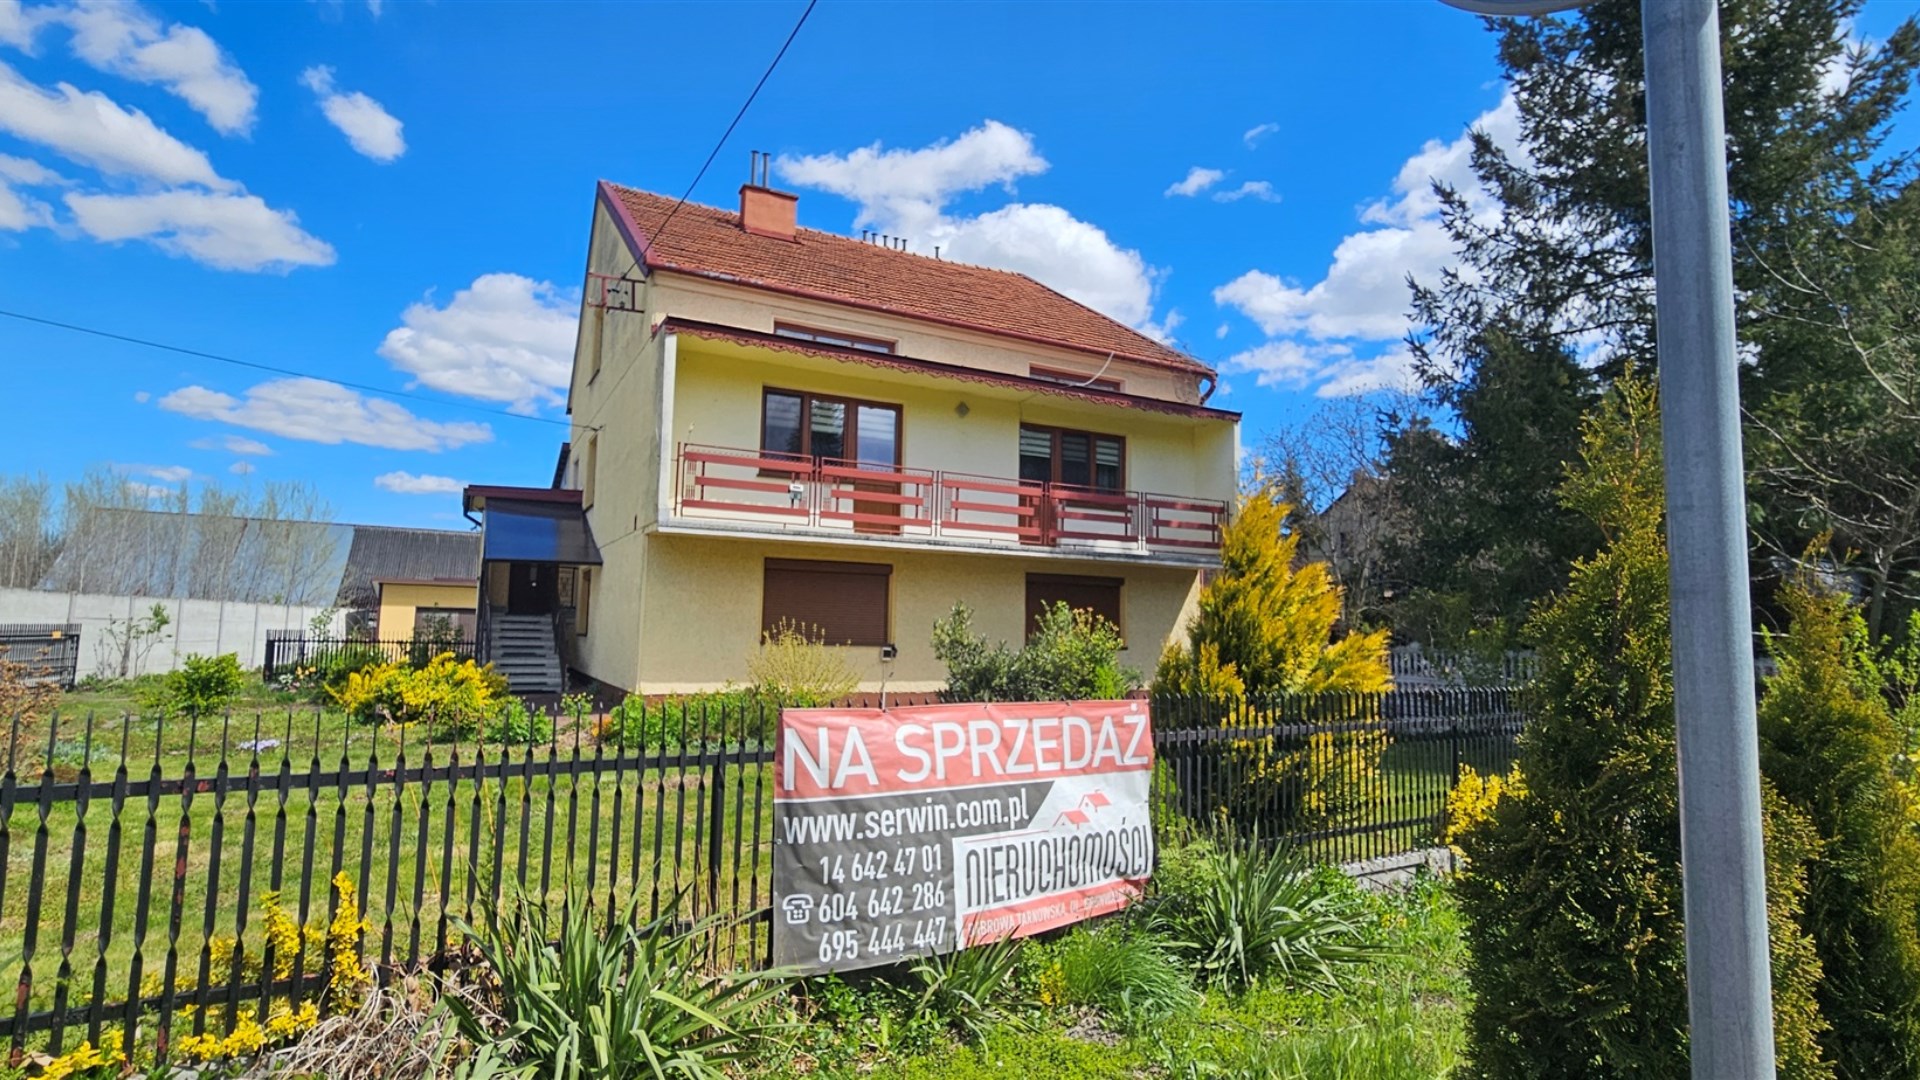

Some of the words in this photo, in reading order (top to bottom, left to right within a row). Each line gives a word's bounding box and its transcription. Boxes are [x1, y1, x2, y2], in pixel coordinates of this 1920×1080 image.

[784, 726, 879, 791] NA
[896, 703, 1149, 783] SPRZEDAŻ
[783, 788, 1029, 845] www.serwin.com.pl
[819, 856, 845, 885] 14
[851, 851, 888, 882] 642
[893, 847, 916, 876] 47
[922, 843, 942, 873] 01
[966, 816, 1149, 908] NIERUCHOMOŚCI
[818, 891, 859, 923] 604
[867, 886, 904, 918] 642
[912, 880, 945, 912] 286
[819, 930, 859, 963] 695
[868, 923, 905, 955] 444
[913, 916, 947, 948] 447
